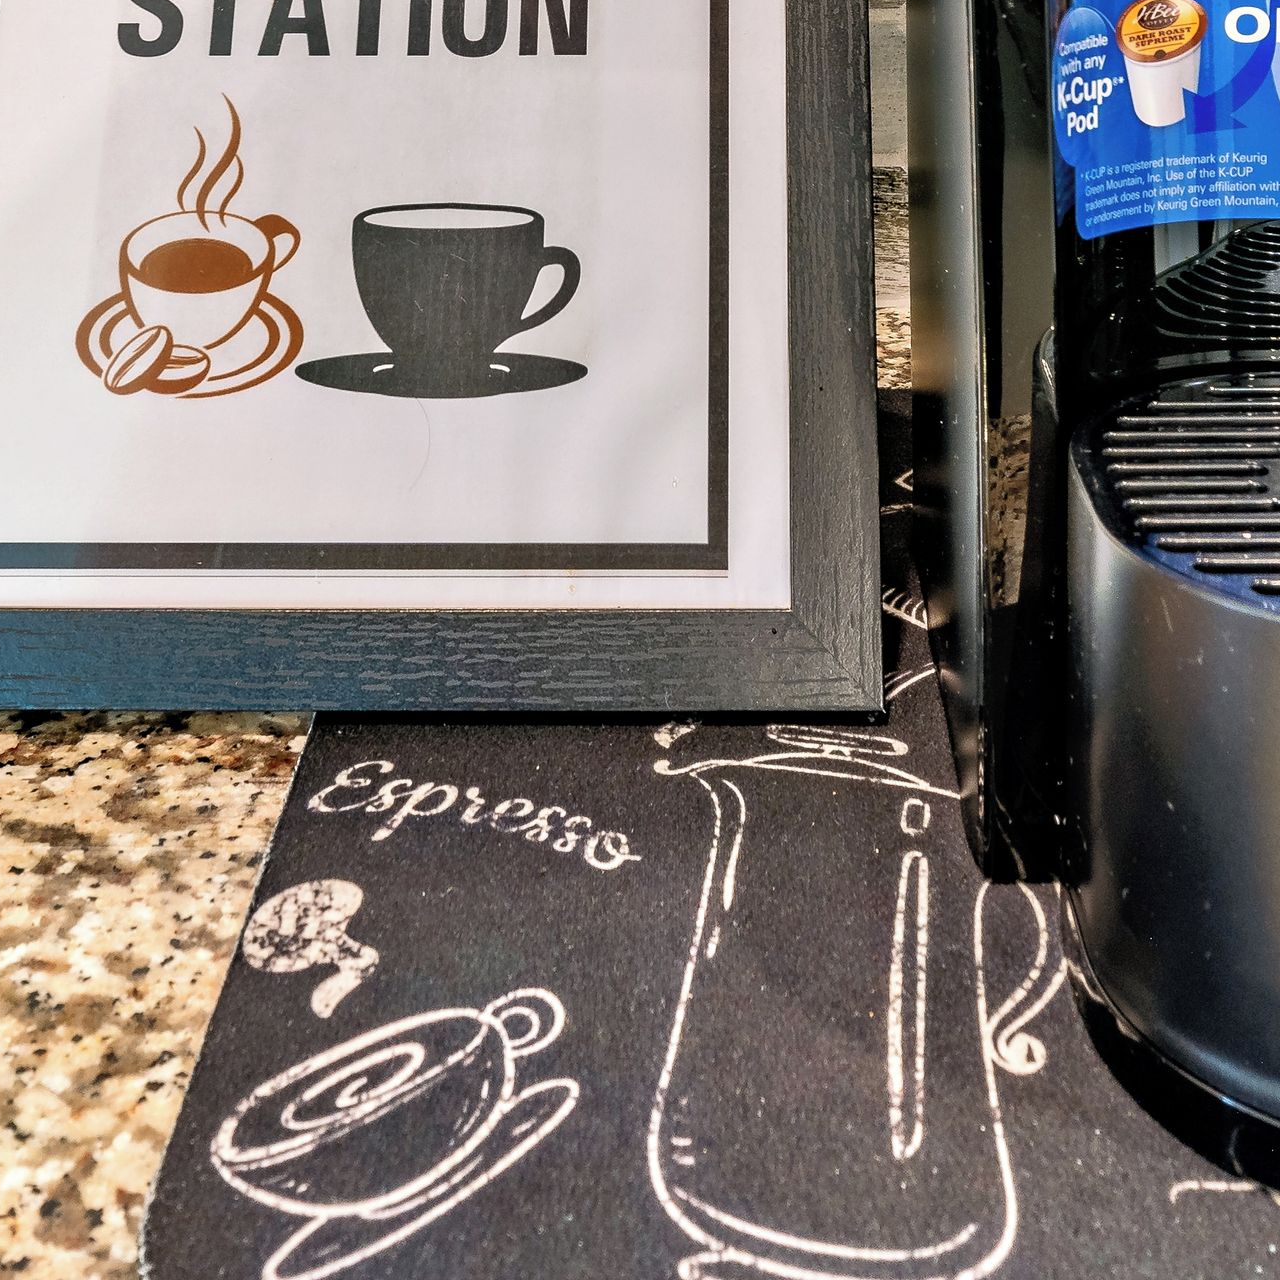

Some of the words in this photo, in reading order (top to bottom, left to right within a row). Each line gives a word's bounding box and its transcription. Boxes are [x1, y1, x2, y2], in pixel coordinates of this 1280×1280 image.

[1059, 34, 1108, 56] Compatible
[1129, 31, 1156, 43] DARK
[1158, 27, 1192, 37] ROAST
[1135, 34, 1185, 47] SUPREME
[1059, 58, 1081, 77] with
[1084, 55, 1106, 70] any
[1067, 105, 1098, 137] Pod
[1121, 157, 1164, 174] registered
[1166, 153, 1216, 167] trademark
[1219, 152, 1230, 163] of
[1232, 152, 1268, 165] Keurig
[1085, 182, 1105, 197] Green
[1106, 175, 1145, 191] Mountain,
[1147, 172, 1163, 183] Inc.
[1165, 169, 1184, 181] Use
[1186, 168, 1198, 179] of
[1199, 167, 1216, 178] the
[1218, 166, 1254, 178] K-CUP
[1085, 194, 1118, 212] trademark
[1120, 190, 1140, 203] does
[1142, 188, 1157, 199] not
[1159, 185, 1186, 200] imply
[1187, 184, 1206, 196] any
[1208, 181, 1256, 193] affiliation
[1093, 205, 1142, 224] endorsement
[1144, 203, 1156, 216] by
[1157, 200, 1188, 213] Keurig
[1190, 197, 1221, 209] Green
[1224, 195, 1280, 208] Mountain,
[307, 759, 642, 871] Espresso
